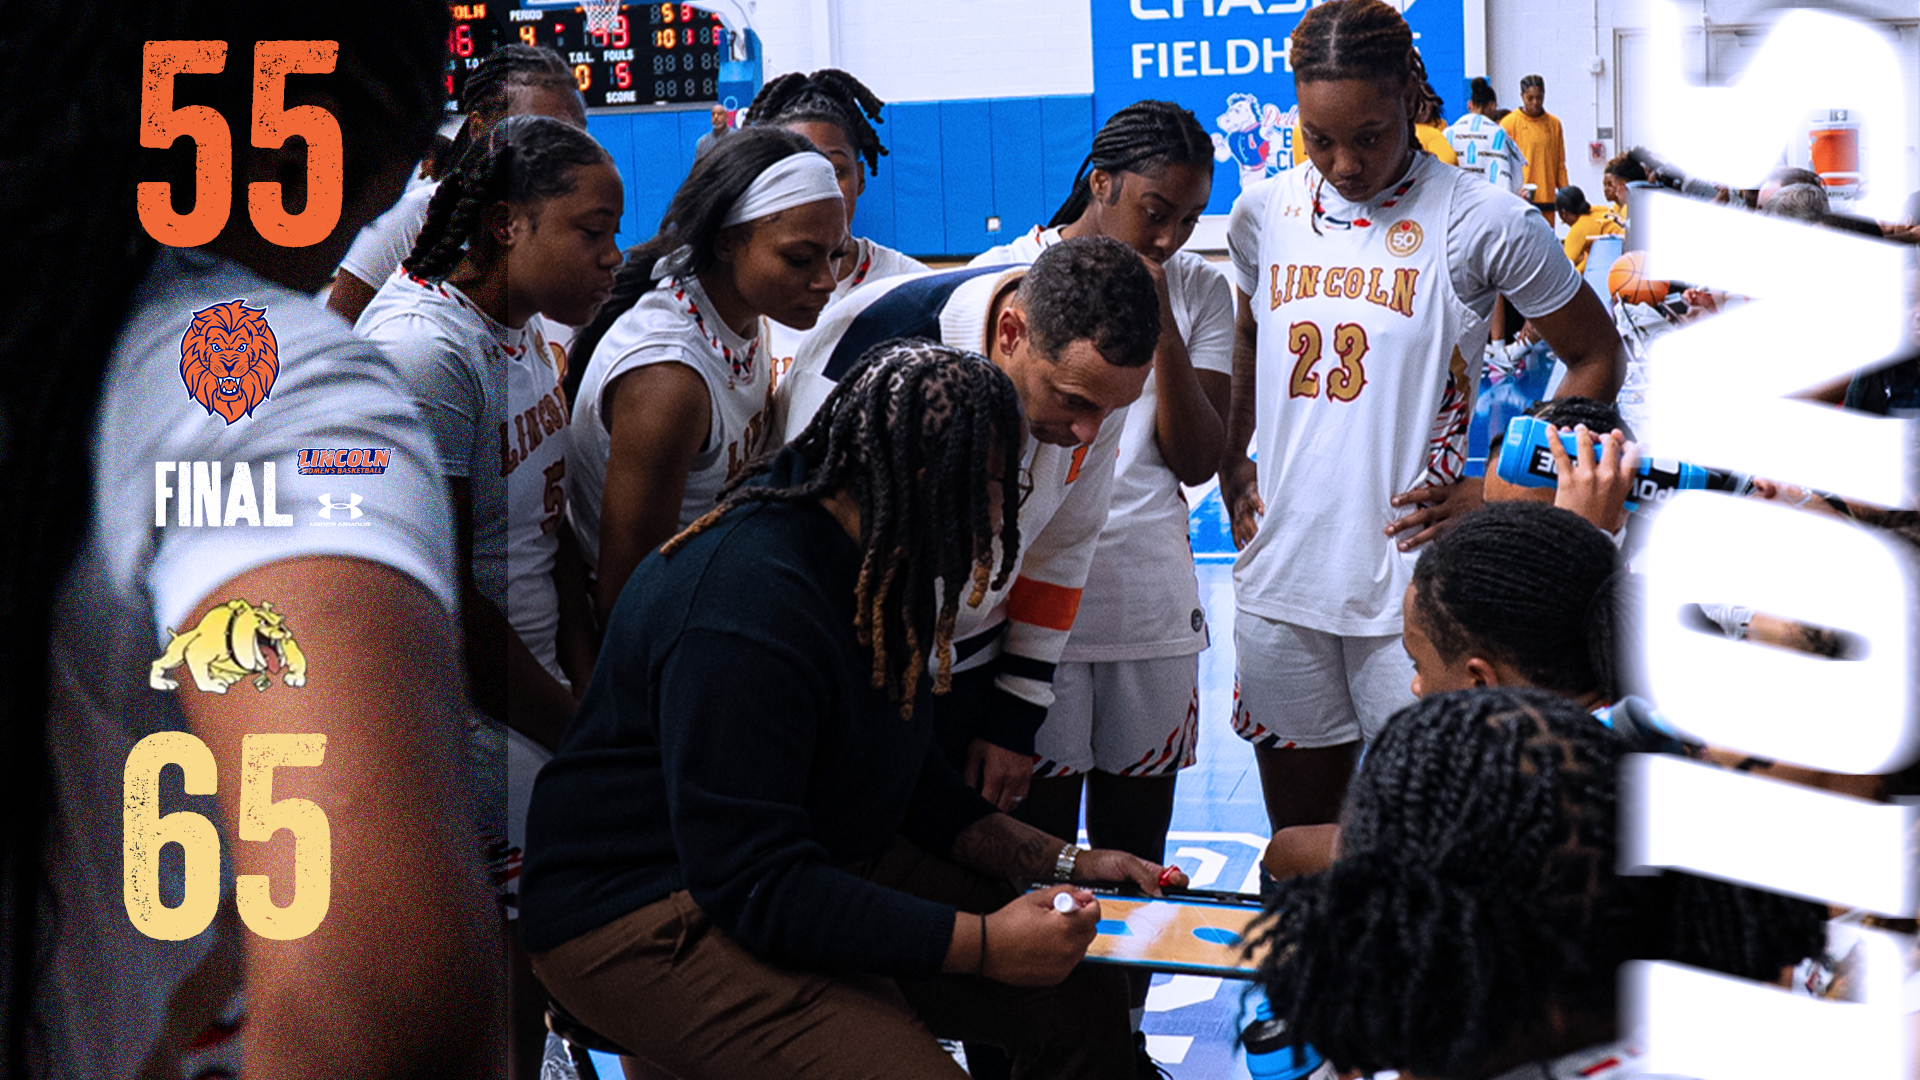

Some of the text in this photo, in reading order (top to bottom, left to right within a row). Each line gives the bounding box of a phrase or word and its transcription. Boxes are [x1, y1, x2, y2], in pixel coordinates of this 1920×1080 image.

[509, 10, 543, 22] PERIOD
[519, 25, 536, 47] 4
[603, 48, 635, 62] FOULS
[605, 90, 637, 104] SCORE
[1392, 231, 1416, 247] 50
[1270, 263, 1420, 318] LINCOLN
[1288, 321, 1371, 403] 23
